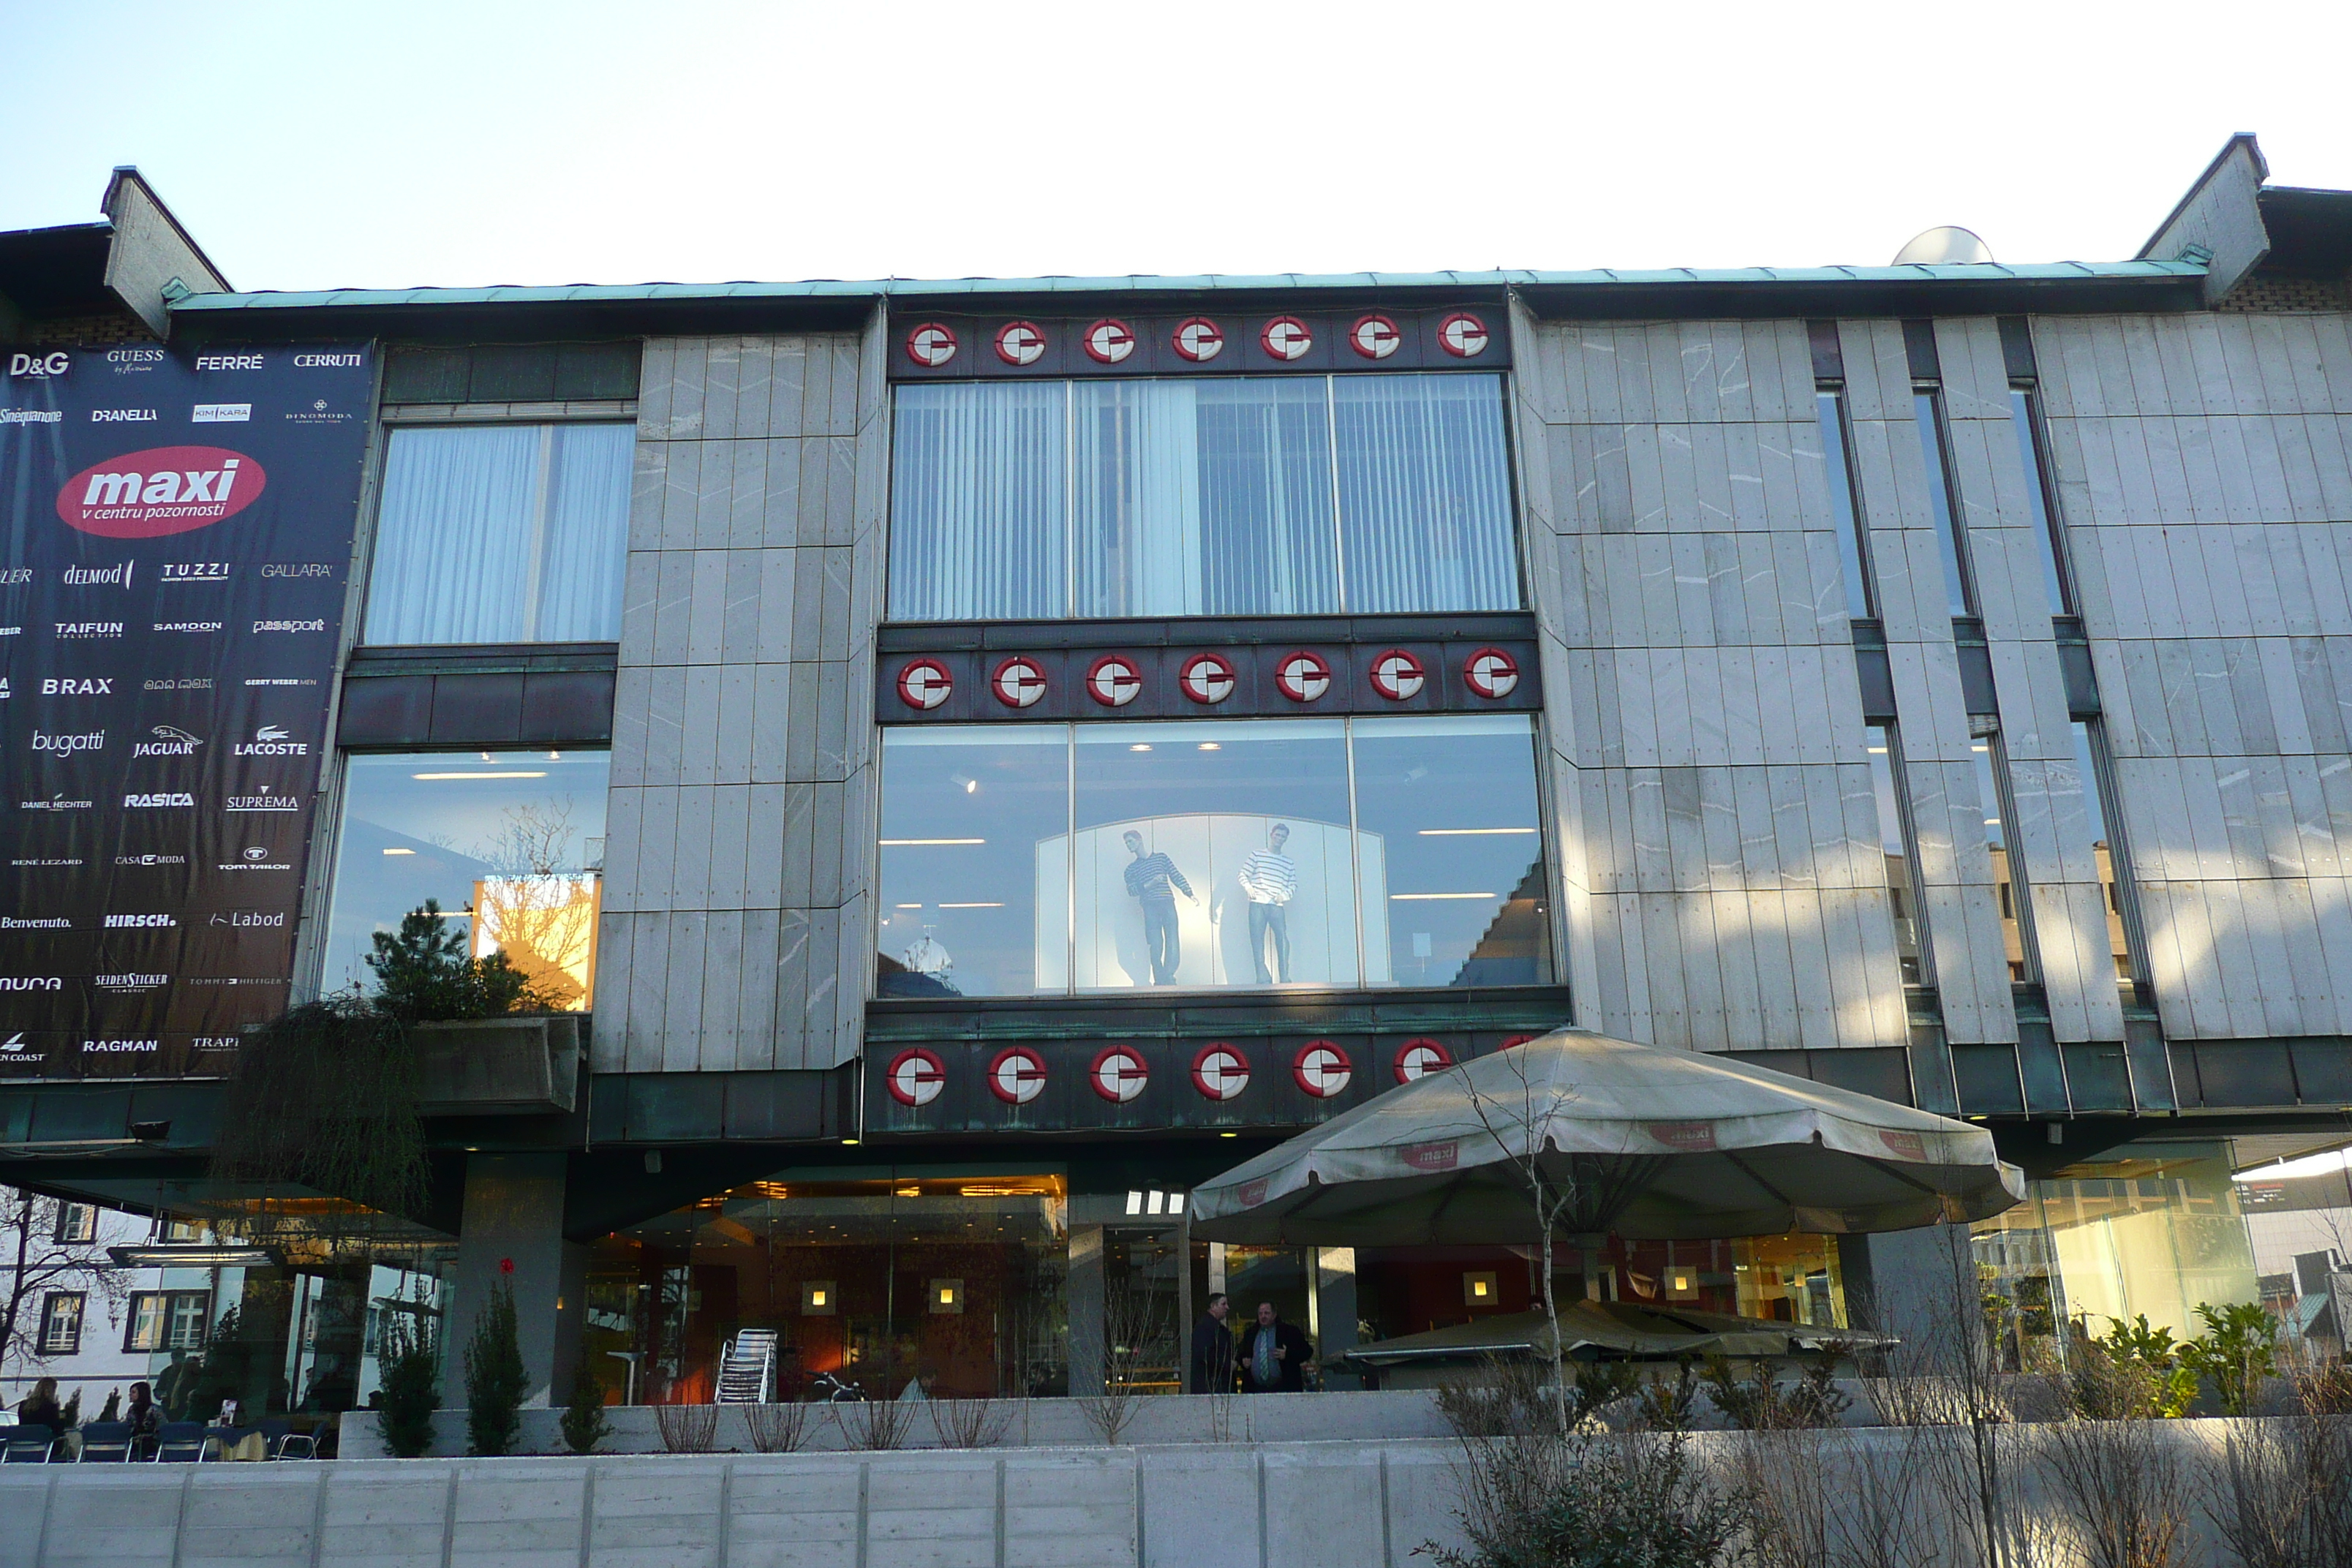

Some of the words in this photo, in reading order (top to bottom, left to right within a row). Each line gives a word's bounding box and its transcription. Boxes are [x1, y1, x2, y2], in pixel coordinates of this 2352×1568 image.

[108, 350, 165, 362] GUESS
[196, 353, 264, 370] FERRÉ
[294, 354, 361, 366] CERRUTI
[10, 352, 69, 376] D&G
[0, 407, 62, 426] Sinéquanone
[92, 410, 158, 422] DRANELLA
[83, 459, 240, 505] maxi
[82, 510, 92, 519] v
[94, 508, 142, 520] centru
[144, 502, 227, 521] pozornosti
[164, 562, 230, 576] TUZZI
[55, 622, 124, 633] TAIFUN
[153, 622, 222, 631] SAMOON
[253, 619, 325, 633] passport
[42, 678, 113, 695] BRAX
[31, 729, 105, 758] bugatti
[132, 743, 194, 758] JAGUAR
[234, 743, 307, 755] LACOSTE
[53, 801, 92, 809] HECHTER
[227, 796, 298, 808] SUPREMA
[115, 856, 140, 864] CASA
[157, 855, 185, 864] MODA
[1, 916, 72, 929] Benvenuto.
[232, 912, 284, 927] Labod
[83, 1040, 158, 1052] RAGMAN
[1420, 1145, 1454, 1161] maxi
